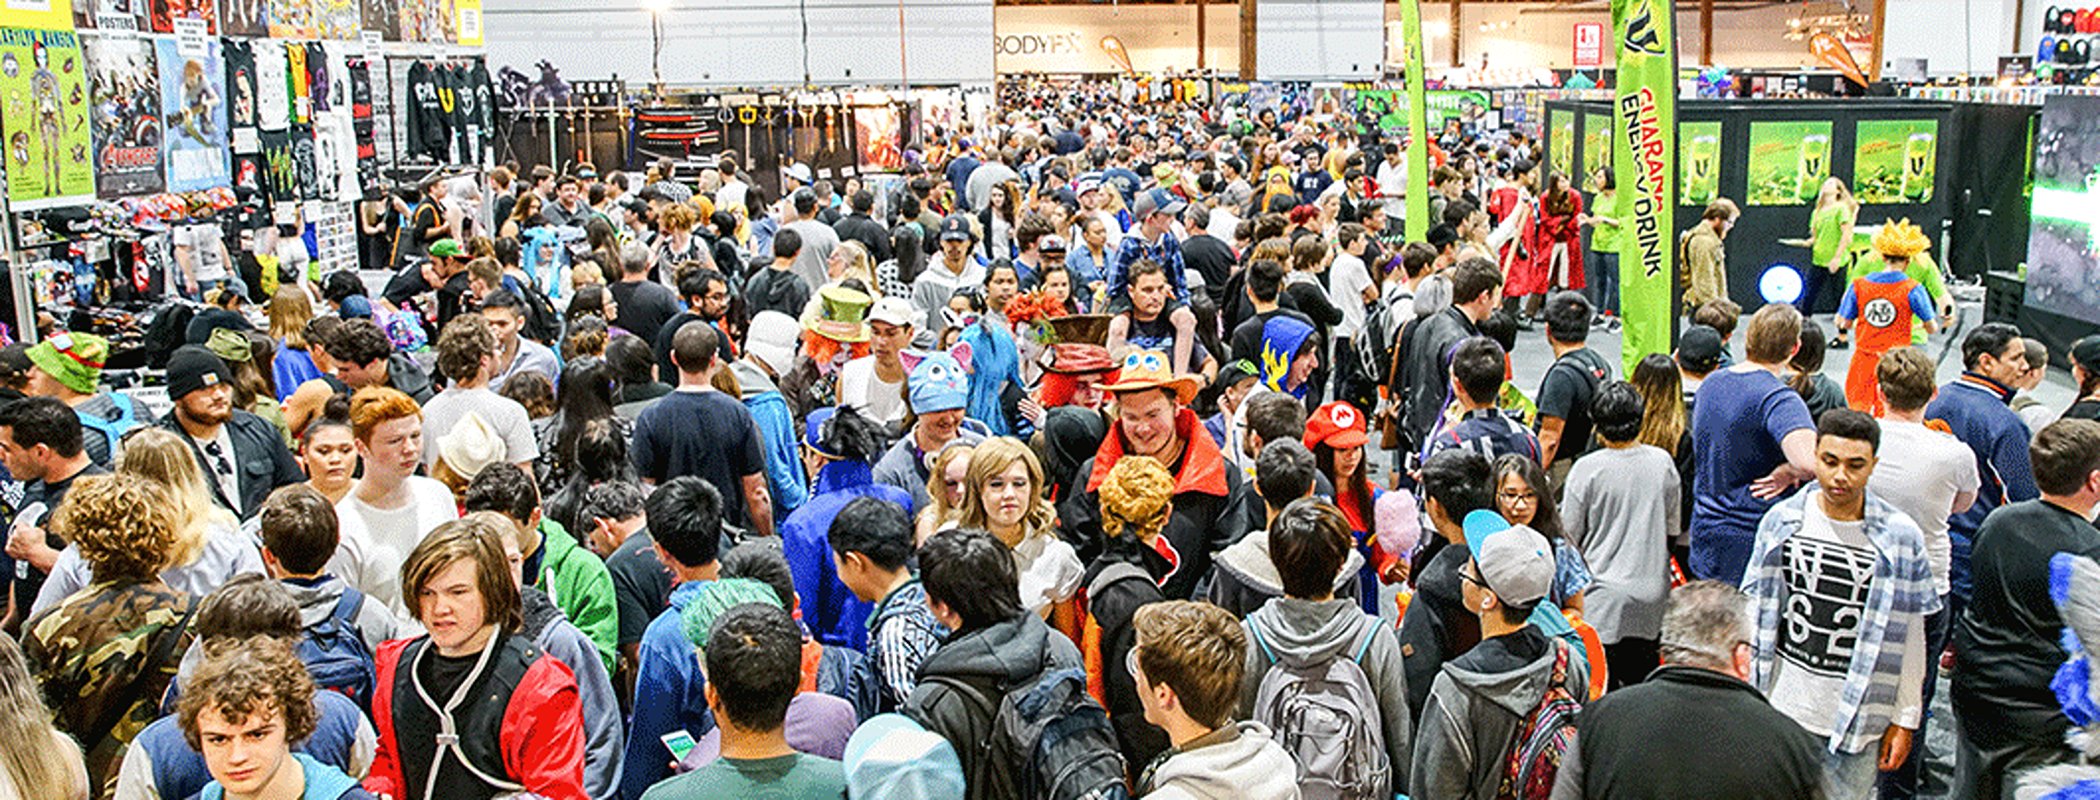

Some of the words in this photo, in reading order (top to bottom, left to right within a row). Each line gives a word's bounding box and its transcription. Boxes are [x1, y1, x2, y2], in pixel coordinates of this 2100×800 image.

[99, 16, 136, 30] POSTERS
[1634, 198, 1662, 278] DRINK
[1335, 408, 1351, 421] M
